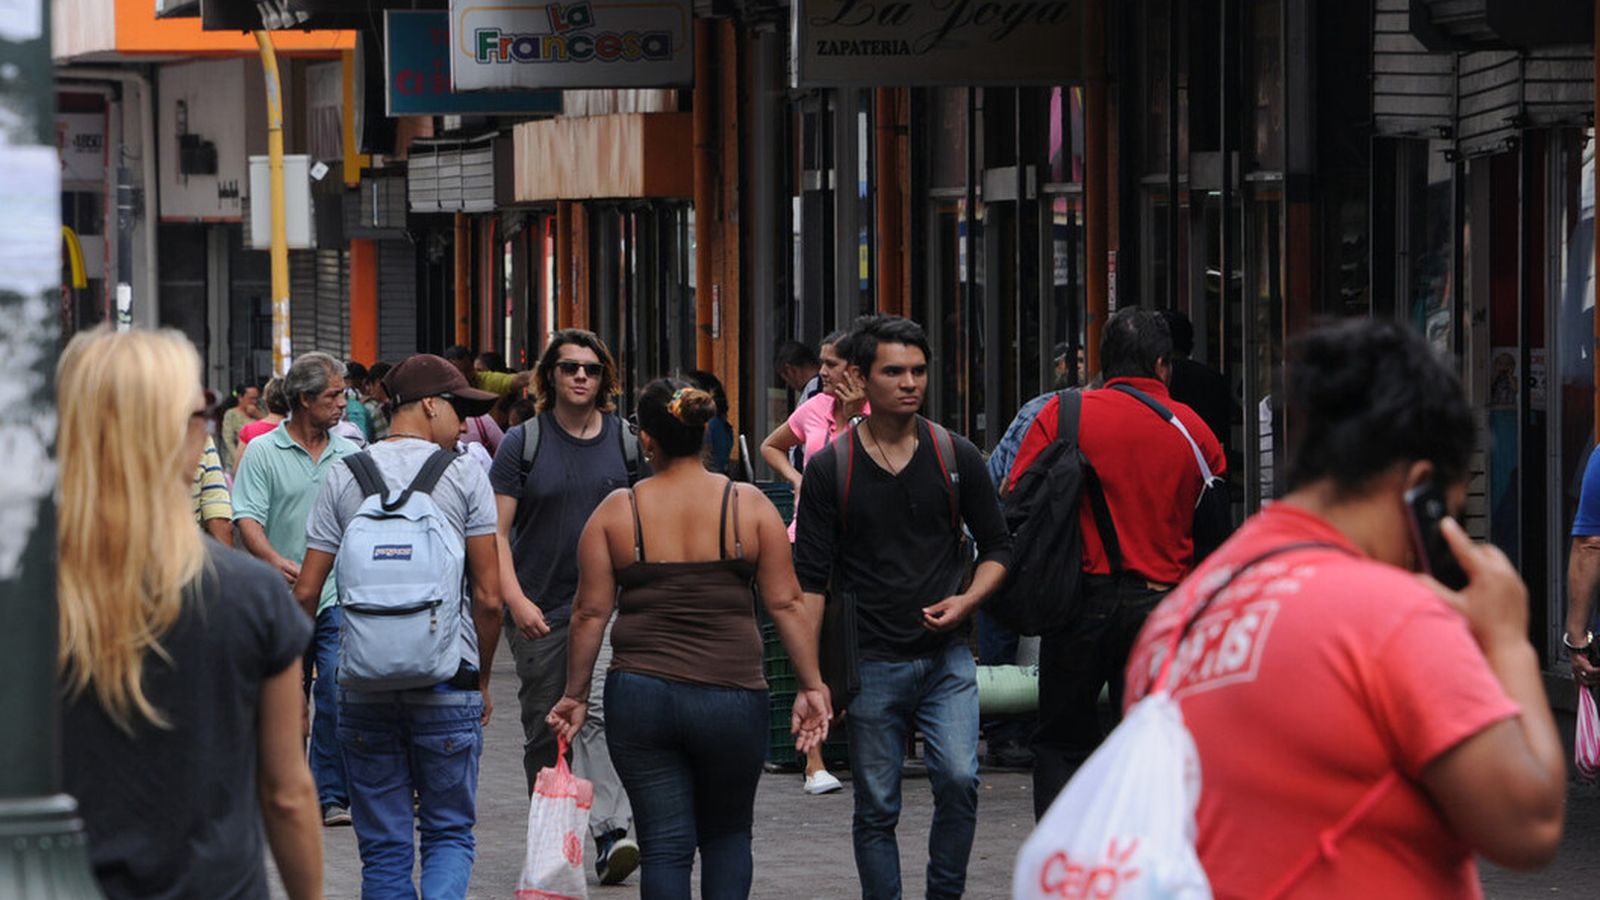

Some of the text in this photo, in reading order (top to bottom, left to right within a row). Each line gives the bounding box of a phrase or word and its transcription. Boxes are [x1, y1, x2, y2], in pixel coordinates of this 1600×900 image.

[548, 3, 593, 32] La
[811, 0, 914, 27] La
[476, 29, 672, 61] Francesa
[817, 40, 912, 56] ZAPATERIA
